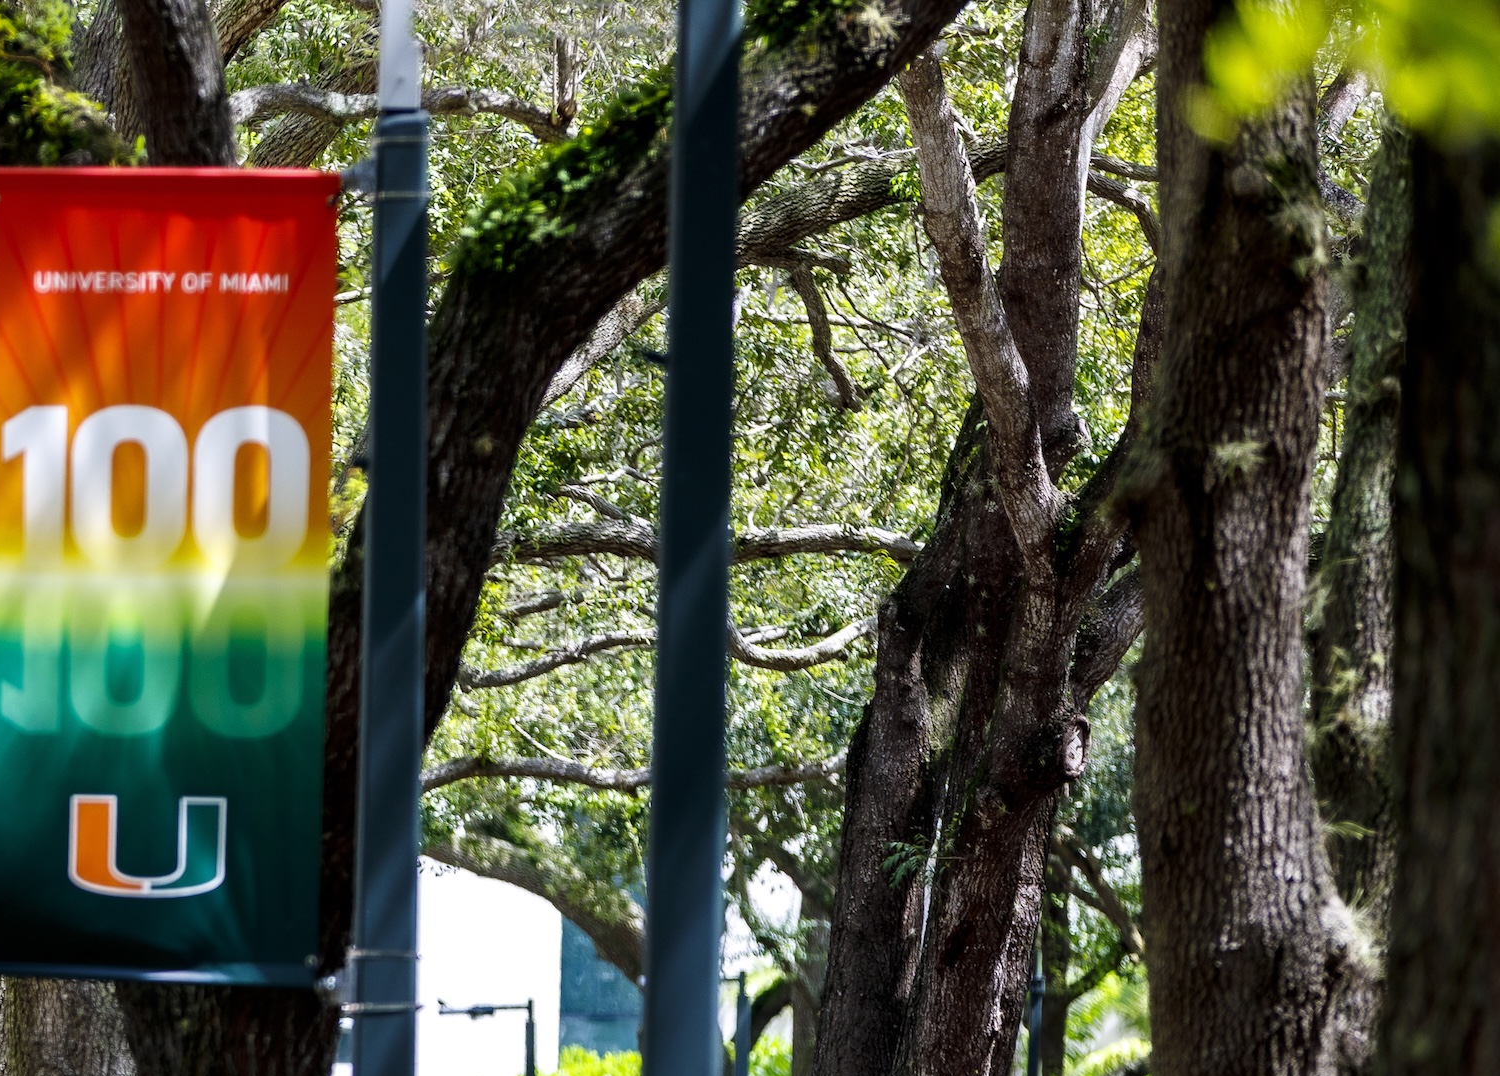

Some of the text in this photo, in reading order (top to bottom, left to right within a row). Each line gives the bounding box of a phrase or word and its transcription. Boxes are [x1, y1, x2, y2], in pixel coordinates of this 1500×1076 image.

[34, 271, 289, 294] UNIVERSITY OF MIAMI
[2, 404, 310, 576] 100
[69, 794, 228, 898] U
